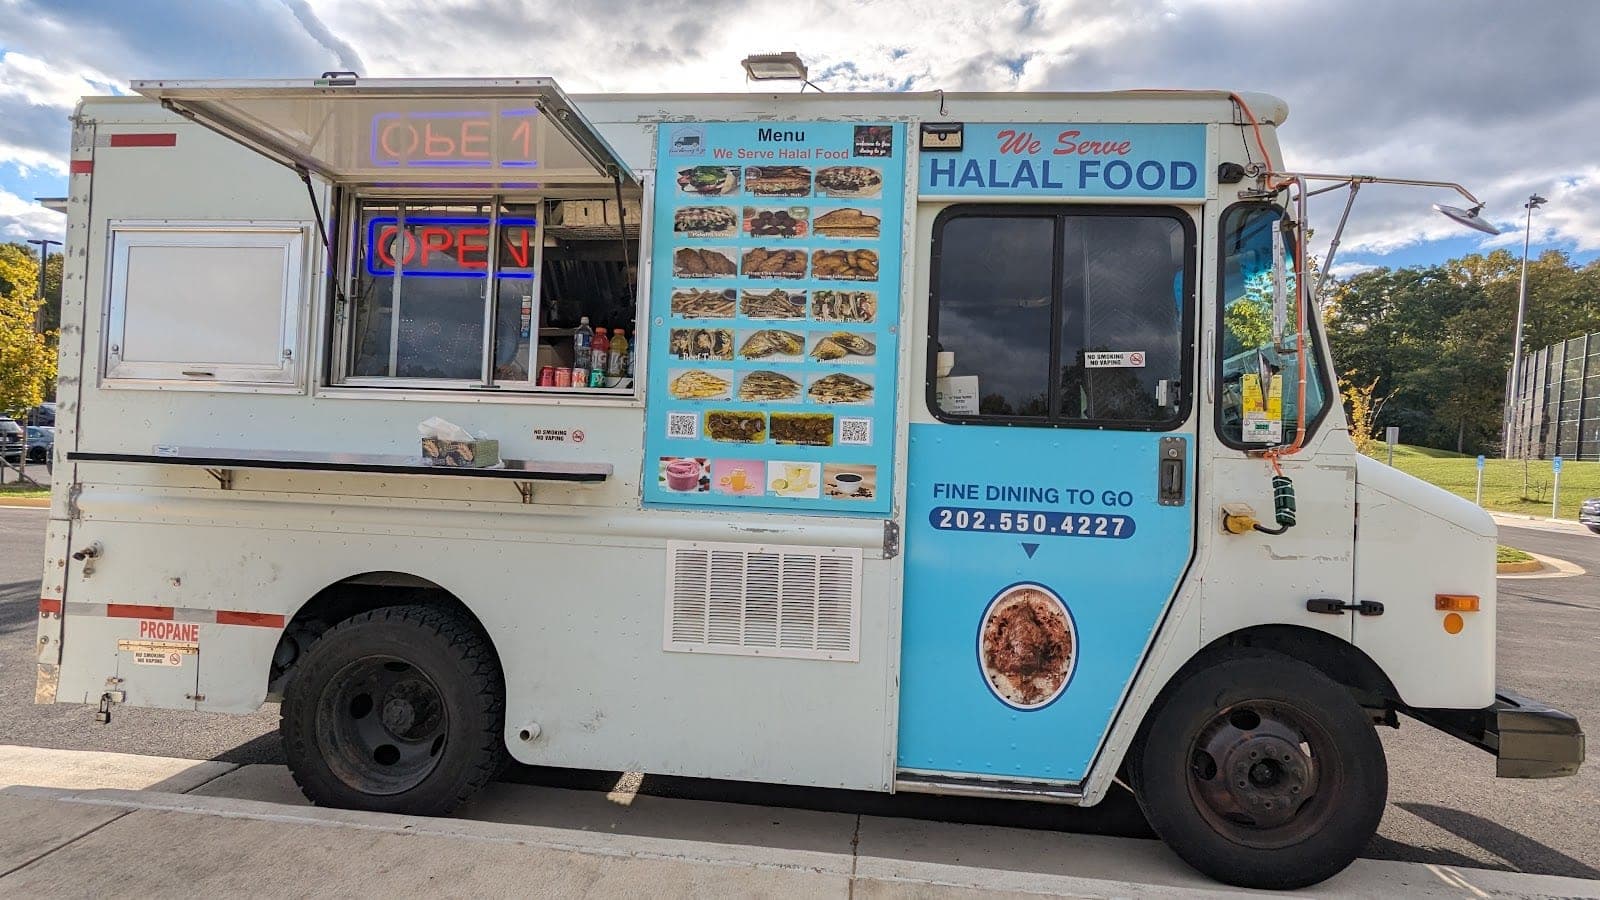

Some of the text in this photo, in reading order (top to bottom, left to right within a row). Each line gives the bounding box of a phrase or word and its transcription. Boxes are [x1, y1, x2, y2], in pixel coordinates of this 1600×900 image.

[758, 128, 805, 142] Menu
[996, 129, 1132, 156] We Serve
[713, 148, 733, 159] We
[737, 148, 774, 159] Serve
[778, 148, 811, 159] Halal
[815, 148, 849, 159] Food
[930, 158, 1198, 191] HALAL FOOD
[683, 352, 702, 360] Beef
[933, 483, 1134, 507] FINE DINING TO GO
[940, 510, 1125, 536] 202.550.4227
[140, 621, 199, 642] PROPANE
